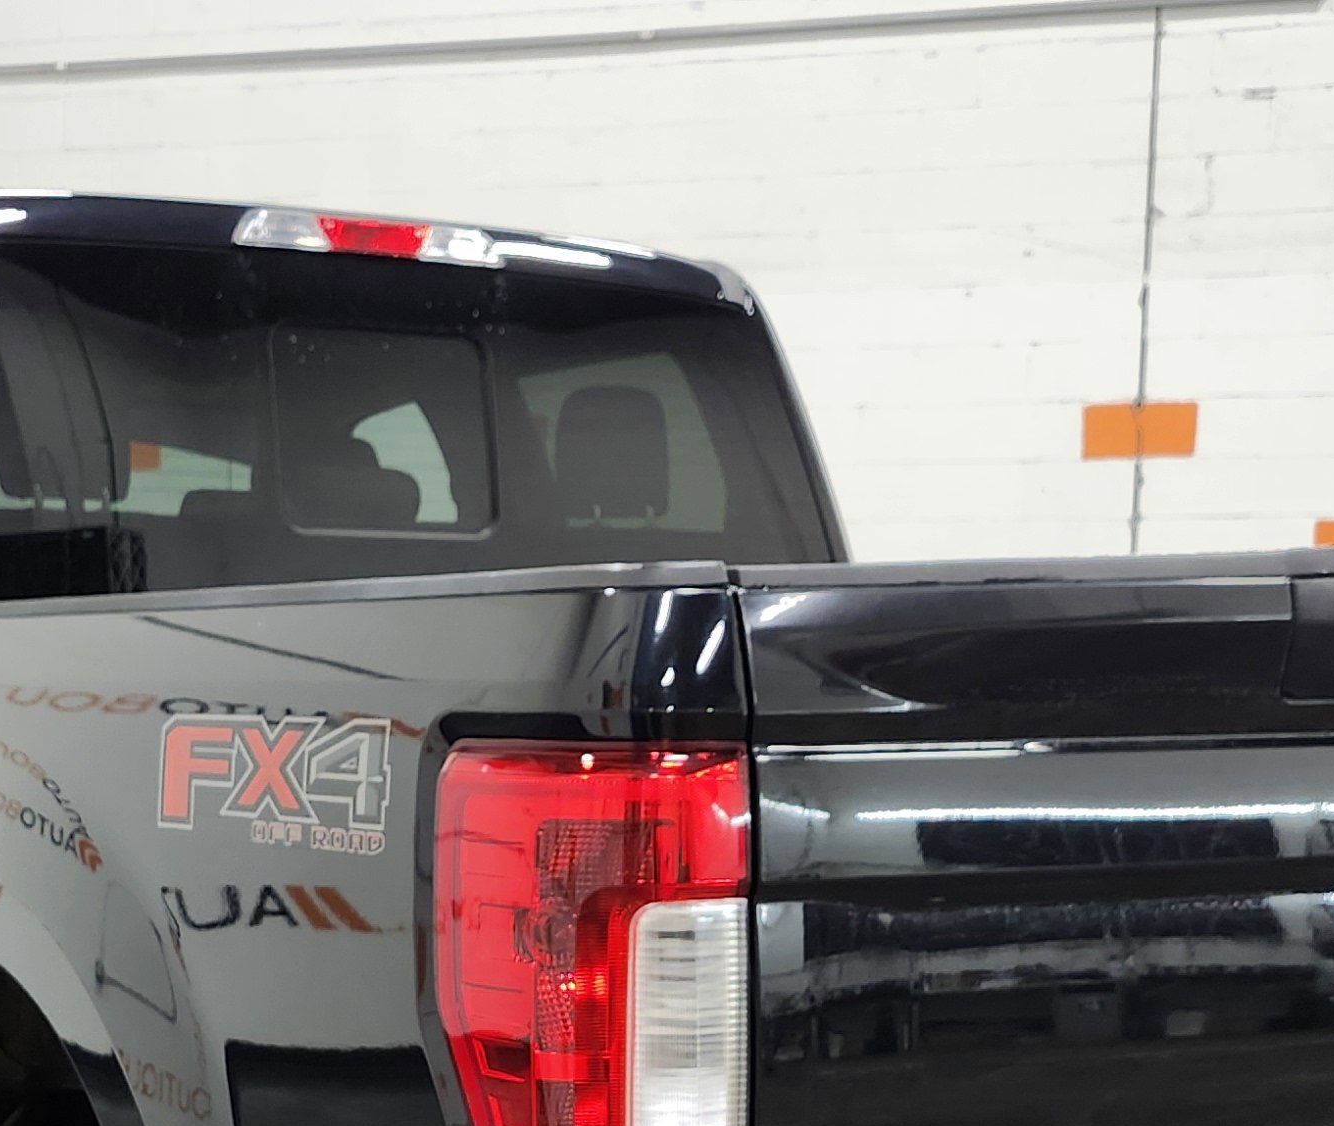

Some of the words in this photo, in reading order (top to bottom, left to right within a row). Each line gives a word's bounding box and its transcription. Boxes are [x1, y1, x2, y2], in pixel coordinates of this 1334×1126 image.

[157, 714, 391, 831] FX4
[251, 820, 303, 845] OFF
[310, 826, 386, 856] ROAD
